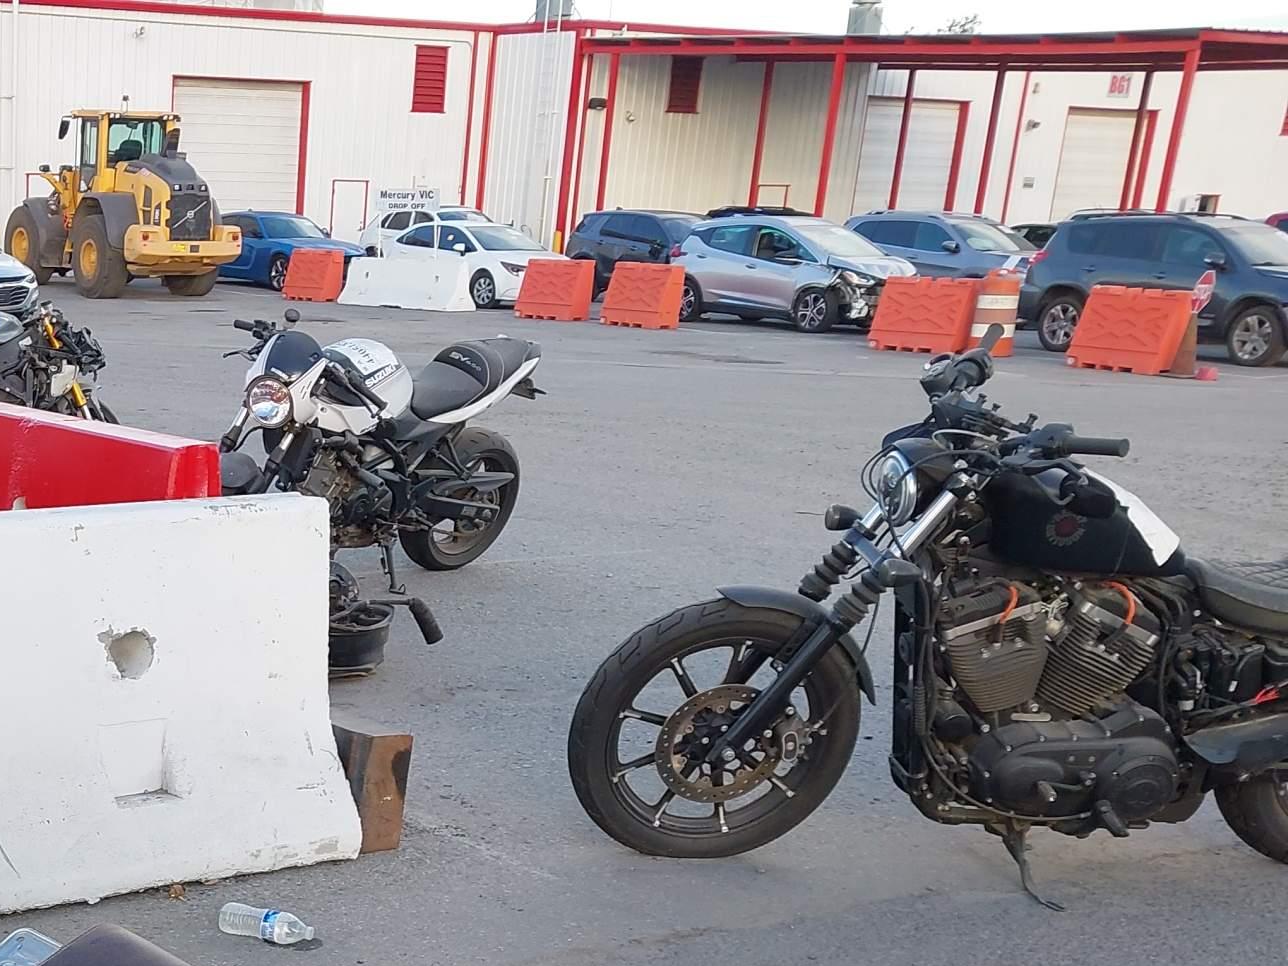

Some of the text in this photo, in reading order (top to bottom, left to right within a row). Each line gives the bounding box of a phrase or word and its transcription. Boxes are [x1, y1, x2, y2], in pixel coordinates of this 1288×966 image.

[380, 190, 434, 201] Mercury VIC
[365, 364, 397, 387] SUZUKI
